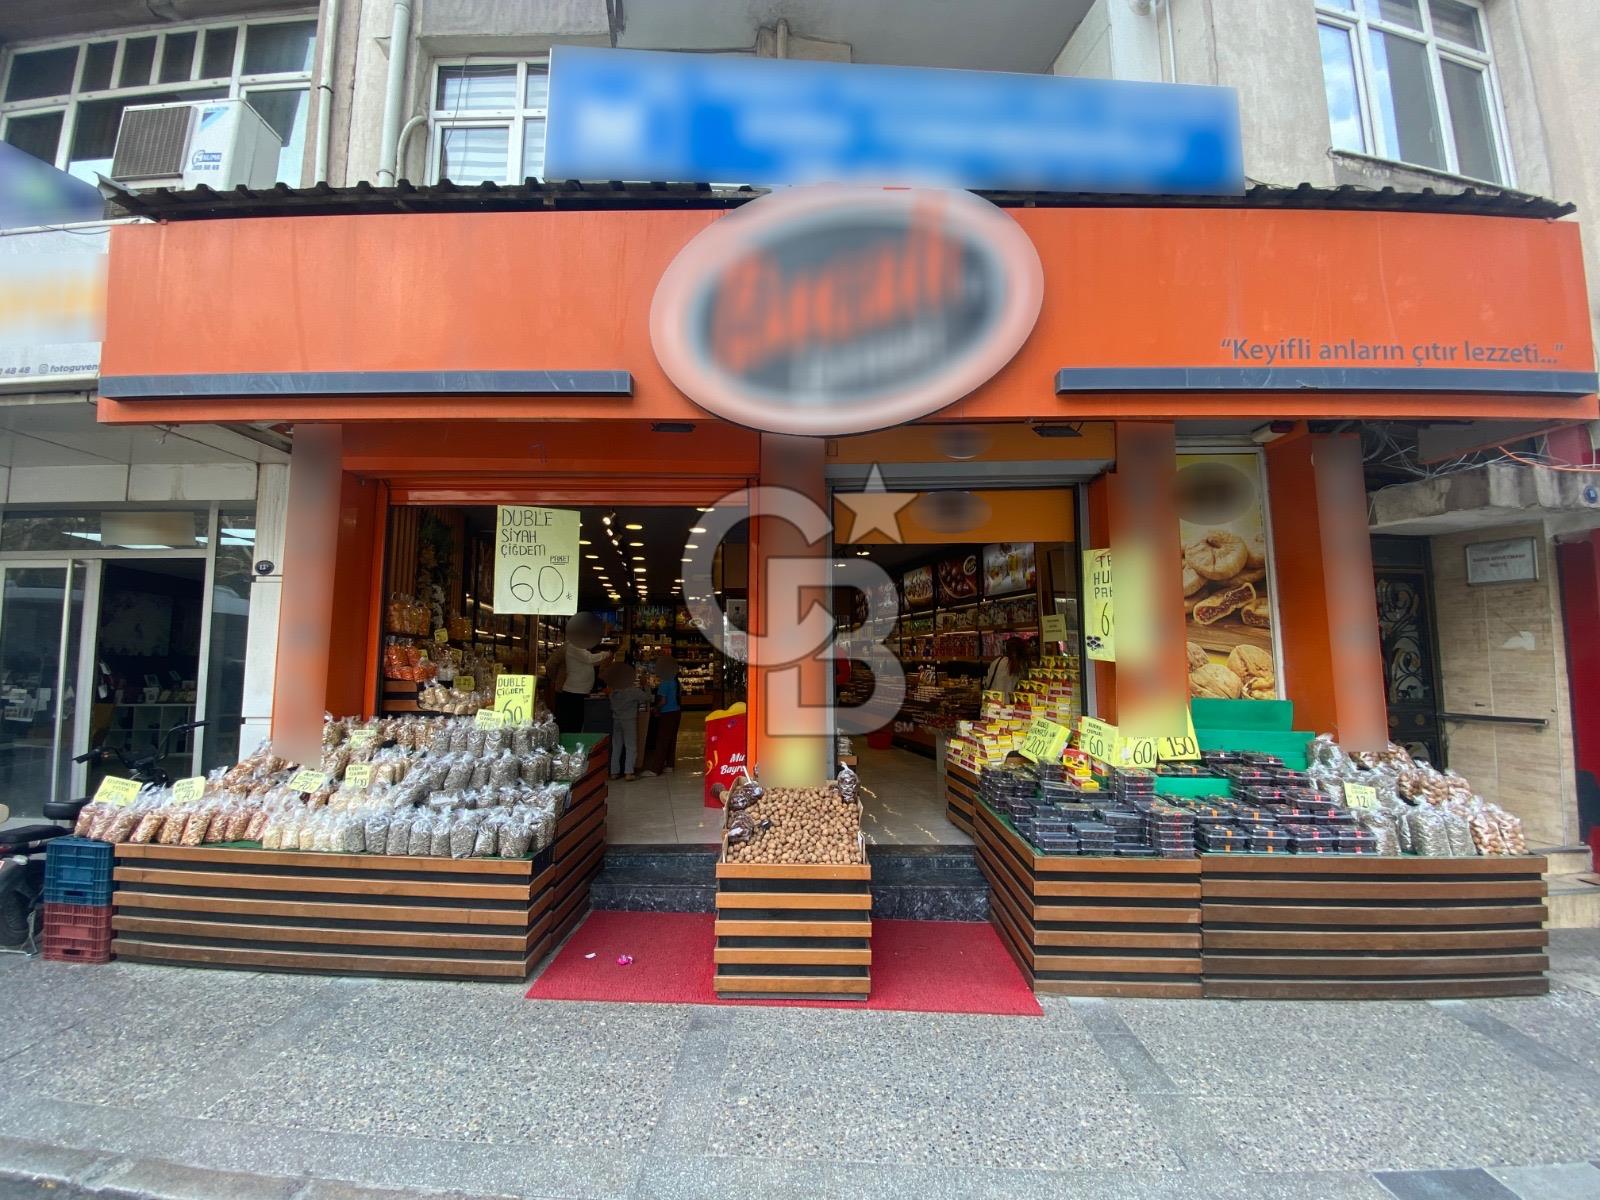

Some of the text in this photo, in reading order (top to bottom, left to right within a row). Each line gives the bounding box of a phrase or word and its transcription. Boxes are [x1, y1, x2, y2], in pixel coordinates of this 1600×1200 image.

[1319, 339, 1404, 360] anların
[1412, 342, 1458, 367] çıtır
[501, 508, 553, 527] DUBLE
[501, 528, 537, 543] SİYAH
[510, 565, 564, 603] 60
[1093, 570, 1113, 586] HU
[1101, 602, 1115, 637] 6
[497, 677, 526, 688] DUBLE
[1089, 735, 1104, 757] 60
[1133, 740, 1153, 765] 60
[1166, 736, 1196, 757] 150
